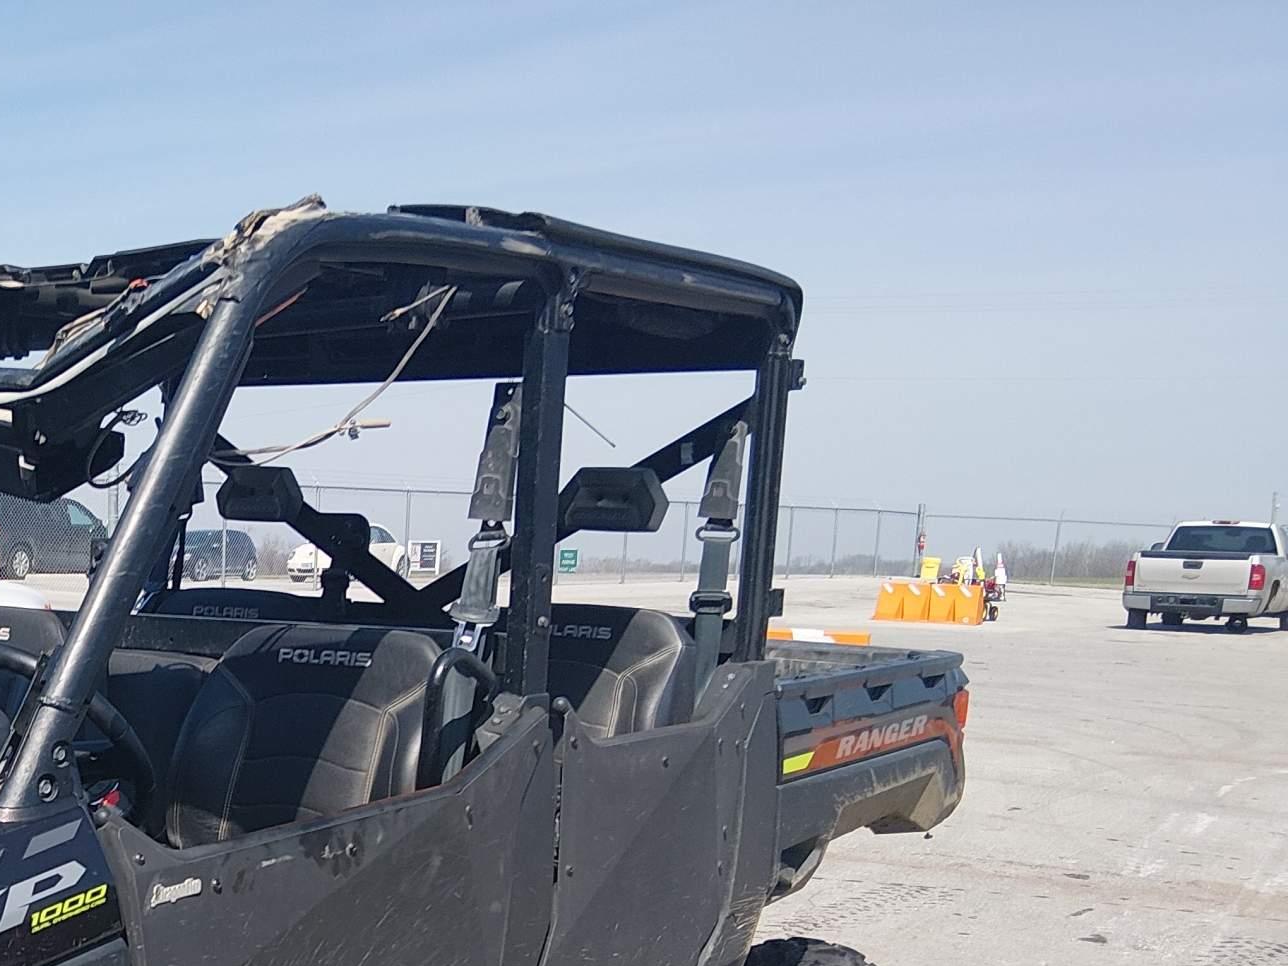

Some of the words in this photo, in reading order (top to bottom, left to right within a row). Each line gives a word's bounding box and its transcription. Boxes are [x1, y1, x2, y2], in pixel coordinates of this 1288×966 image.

[193, 605, 259, 619] POLARIS
[552, 624, 612, 640] LARIS
[278, 648, 372, 668] POLARIS
[835, 714, 928, 760] RANGER
[31, 883, 108, 928] 1000
